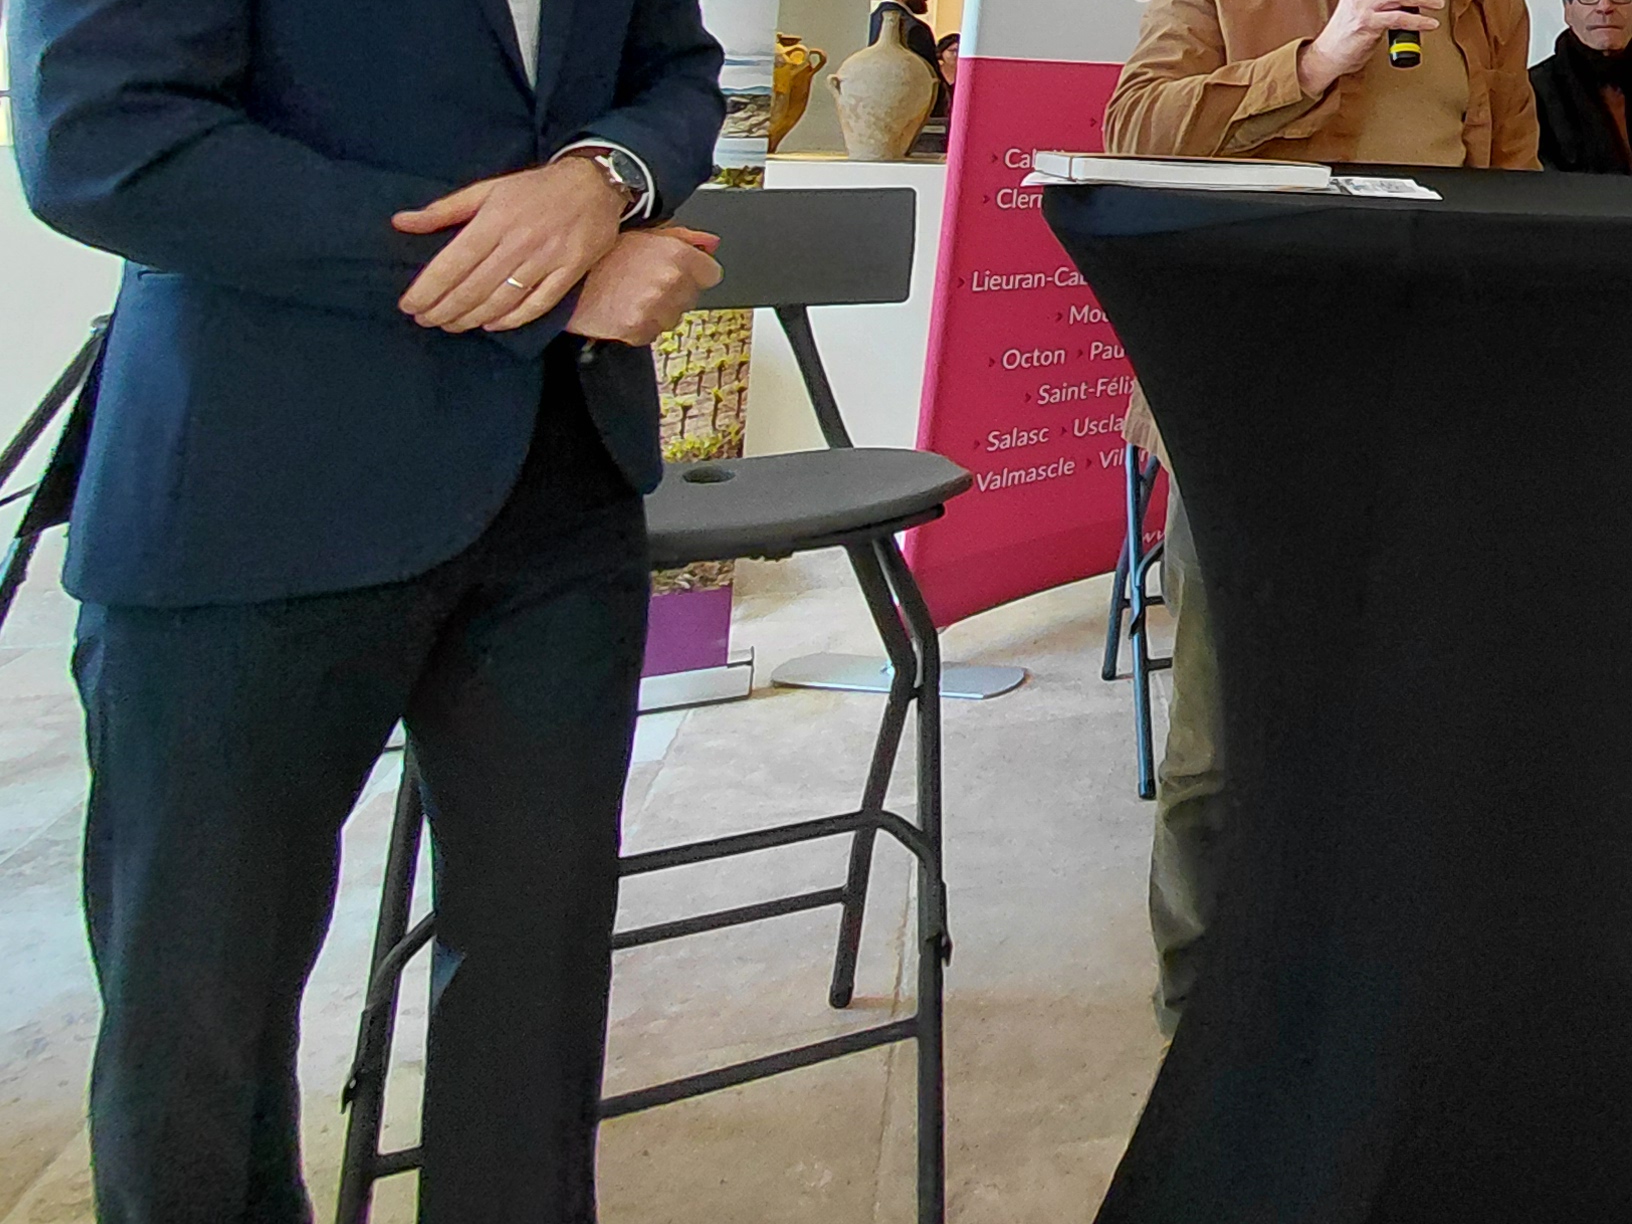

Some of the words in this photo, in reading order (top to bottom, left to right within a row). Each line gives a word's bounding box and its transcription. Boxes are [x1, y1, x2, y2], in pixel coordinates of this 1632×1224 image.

[1002, 347, 1066, 370] Octon
[986, 426, 1050, 452] Salasc
[976, 457, 1076, 493] Valmascle
